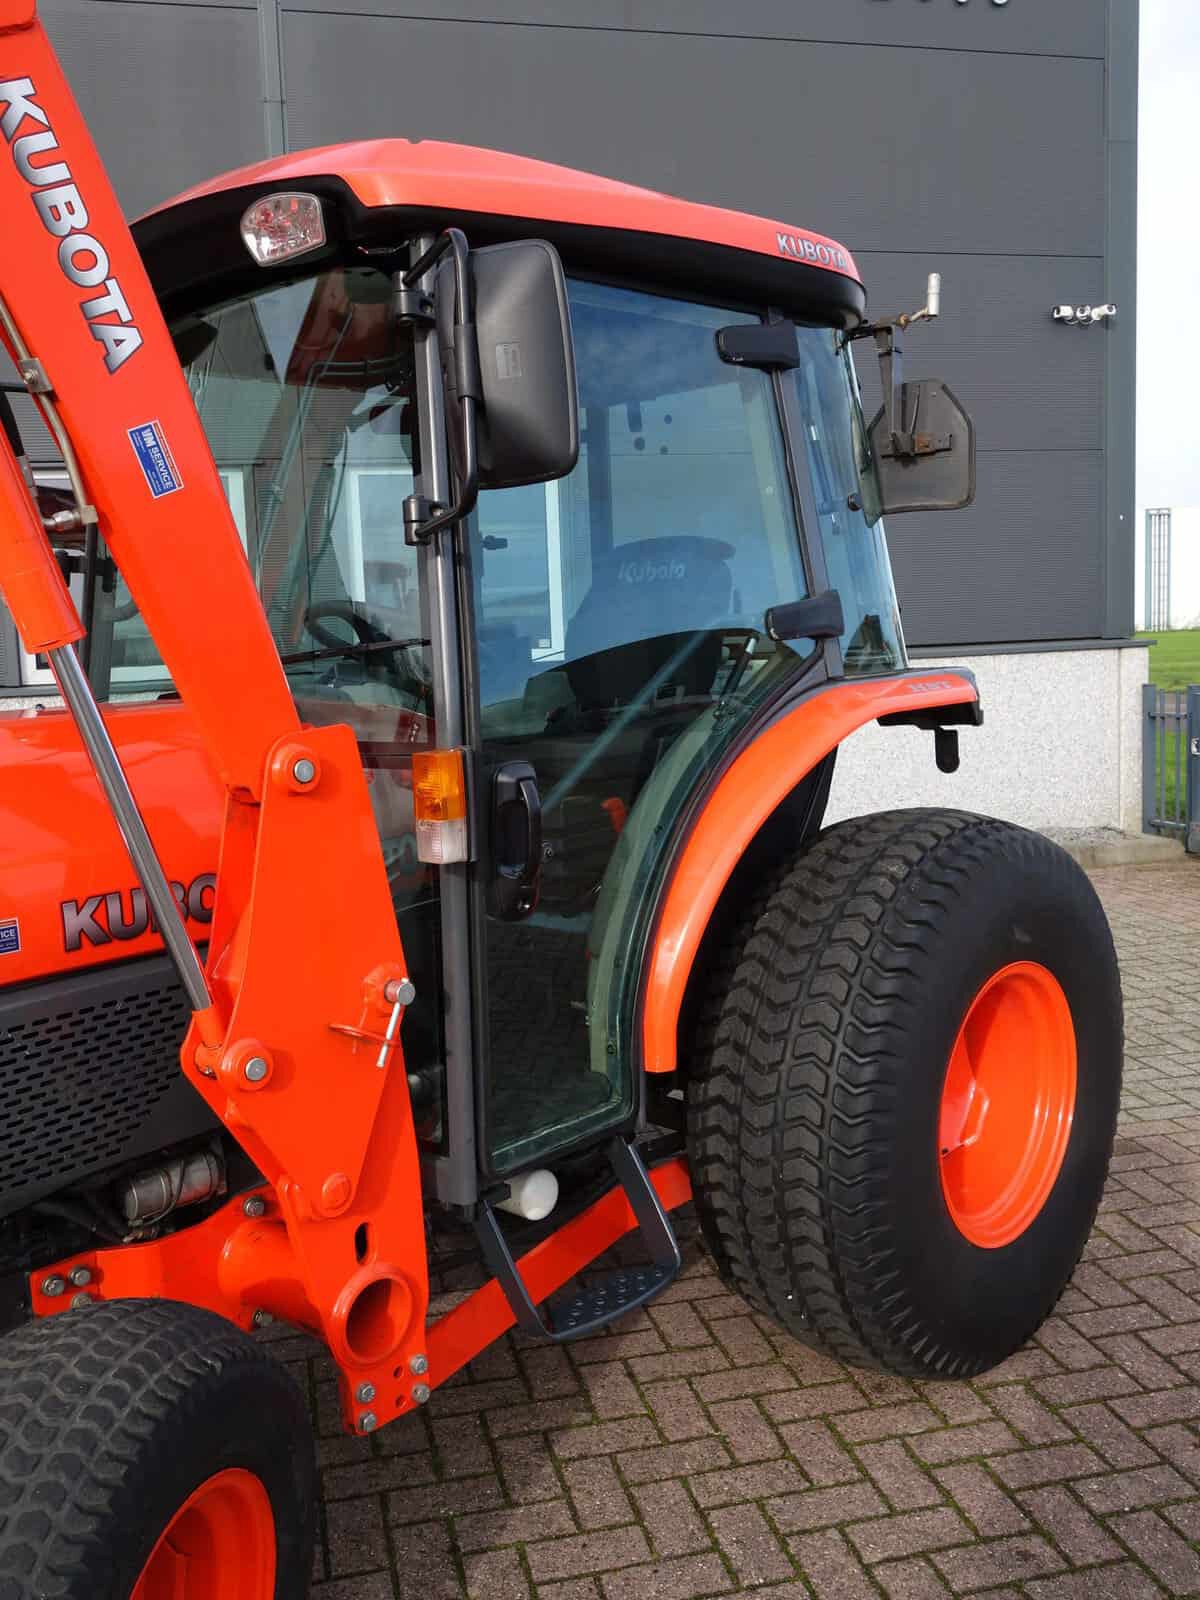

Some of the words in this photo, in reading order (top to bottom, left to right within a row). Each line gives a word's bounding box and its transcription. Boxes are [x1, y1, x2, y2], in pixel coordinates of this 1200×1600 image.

[0, 76, 144, 376] KUBOTA
[776, 231, 848, 272] KUBOTA
[150, 446, 174, 489] SERVICE
